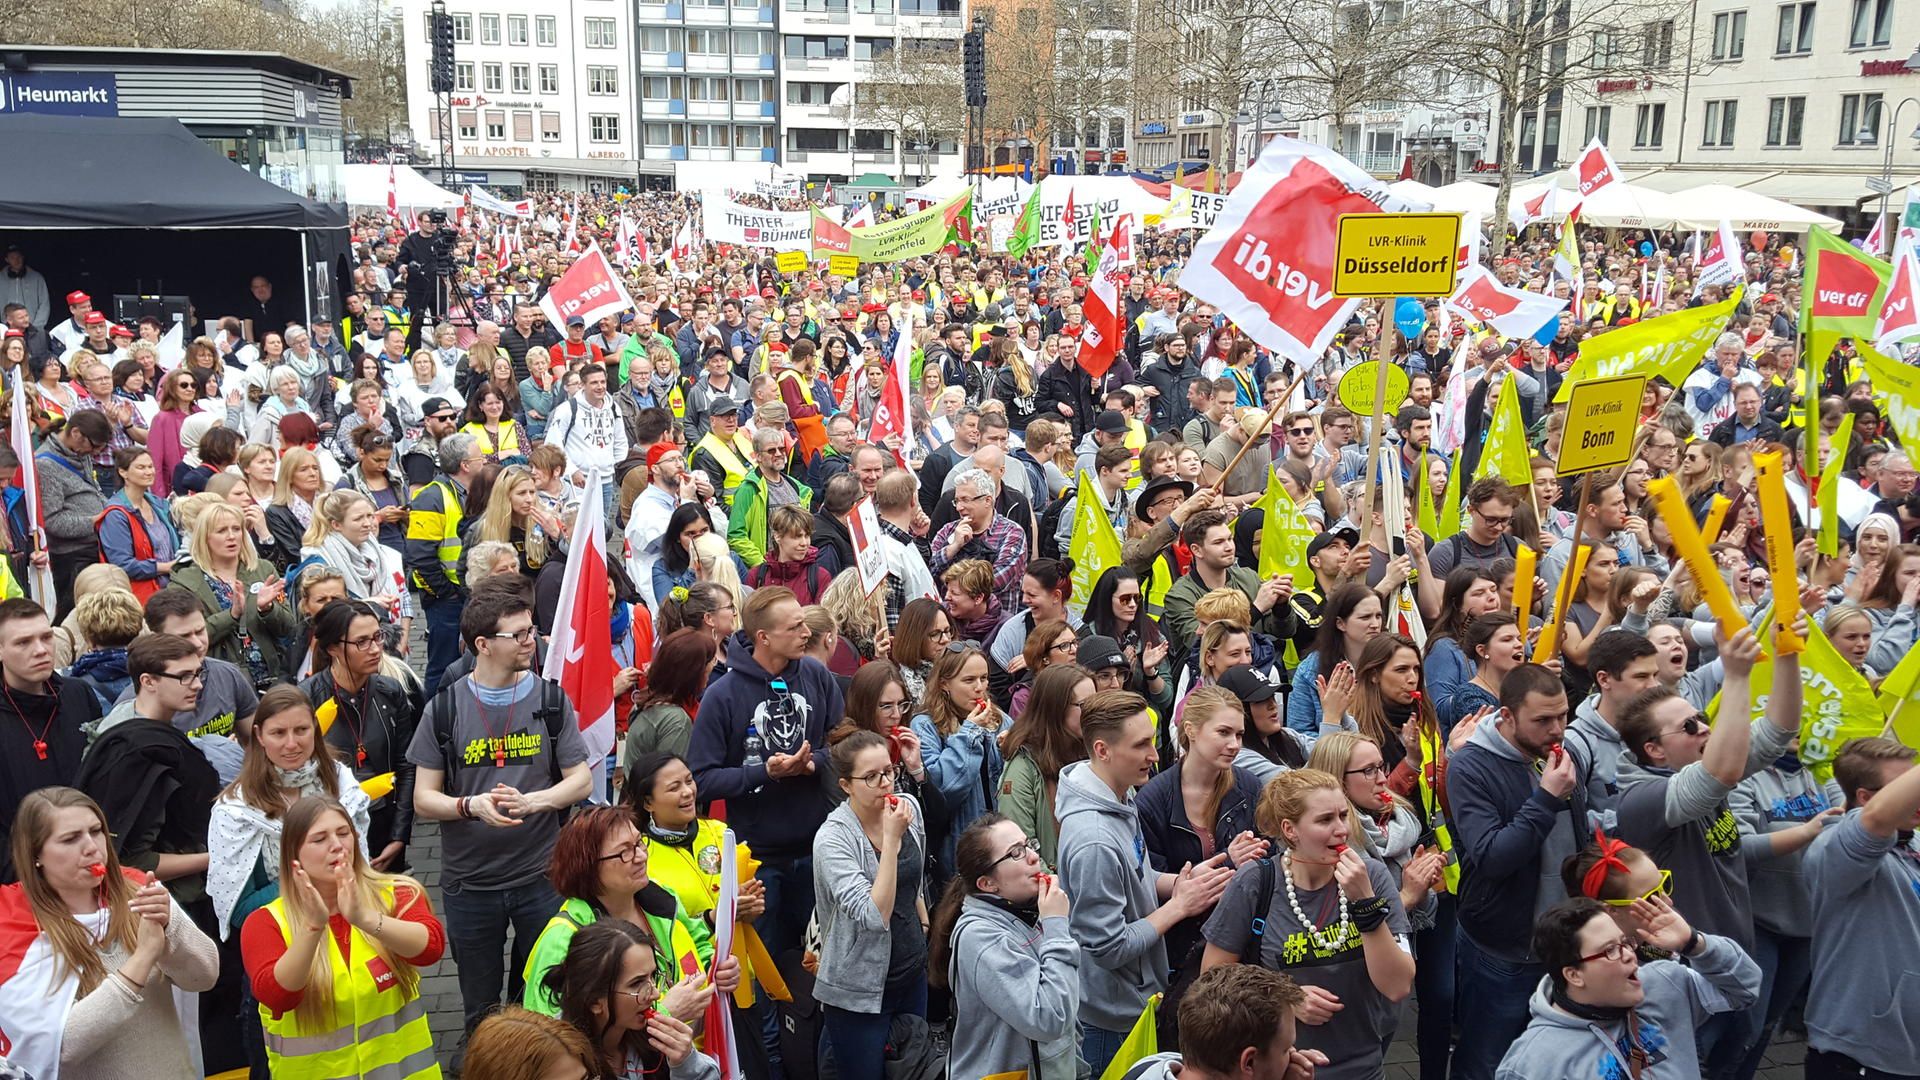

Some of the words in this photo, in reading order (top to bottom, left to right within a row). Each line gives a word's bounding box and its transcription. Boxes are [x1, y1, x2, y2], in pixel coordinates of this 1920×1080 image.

[17, 86, 108, 103] Heumarkt
[463, 146, 480, 156] XII
[484, 146, 532, 157] APOSTEL
[725, 212, 783, 228] THEATER
[1743, 221, 1780, 230] MAREDO
[872, 236, 926, 258] Langenfeld
[1369, 235, 1427, 247] LVR-Klinik
[1344, 256, 1449, 274] Düsseldorf
[1585, 400, 1623, 417] LVR-Klinik
[1581, 430, 1615, 450] Bonn
